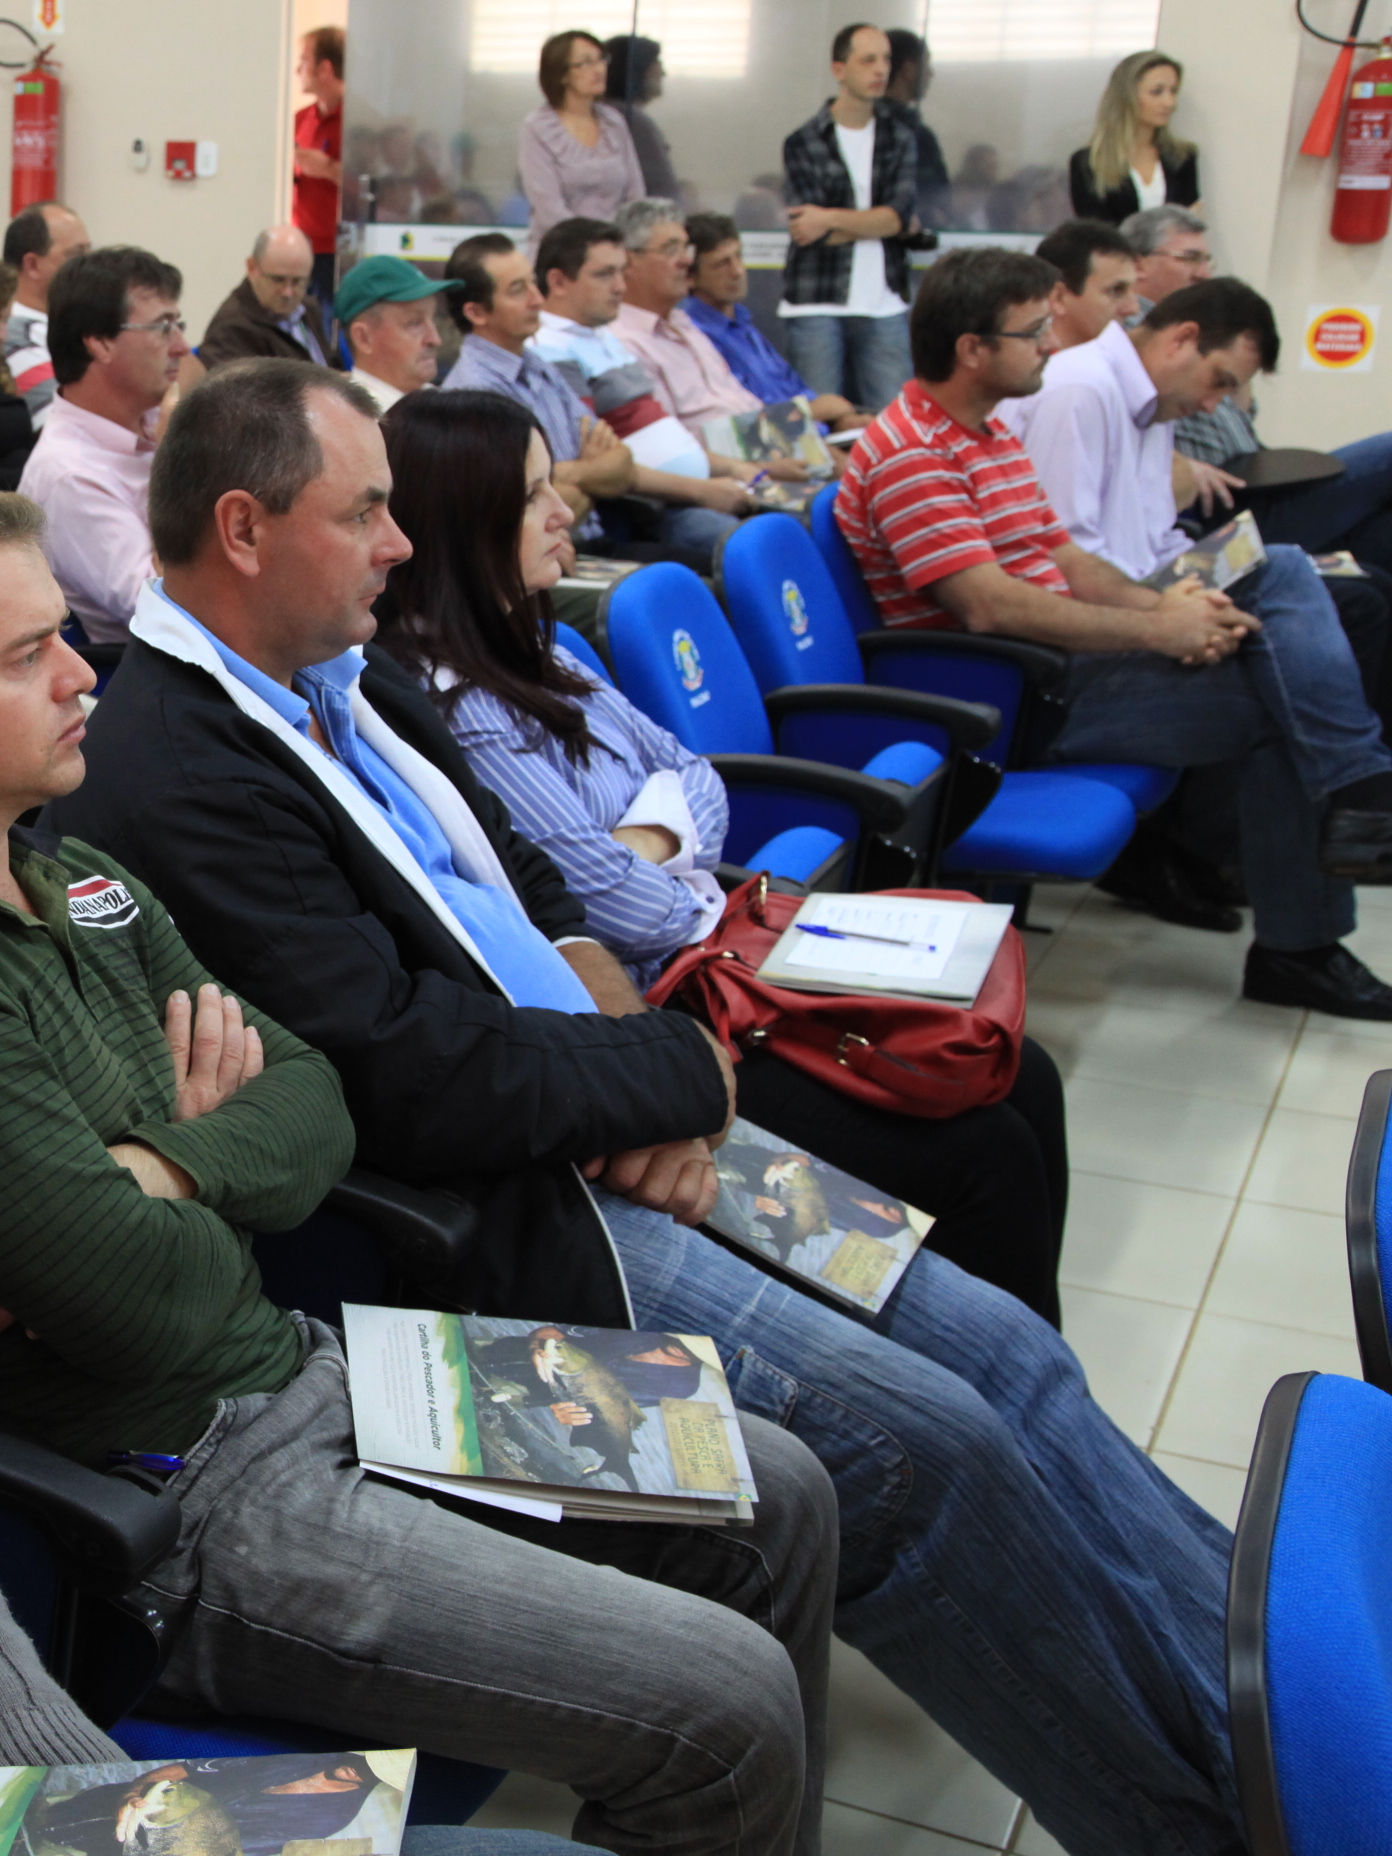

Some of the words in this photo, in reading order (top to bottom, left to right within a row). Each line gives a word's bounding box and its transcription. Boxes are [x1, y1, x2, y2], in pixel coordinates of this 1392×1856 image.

[418, 1323, 430, 1349] Cartilha
[422, 1350, 433, 1360] do
[424, 1361, 437, 1399] Pescador
[427, 1406, 442, 1451] Aquicultor
[692, 1422, 704, 1433] DA
[704, 1418, 720, 1445] PLANO
[679, 1418, 702, 1474] AQUICULTURA
[696, 1436, 711, 1460] PESCA
[711, 1448, 728, 1475] SAFRA
